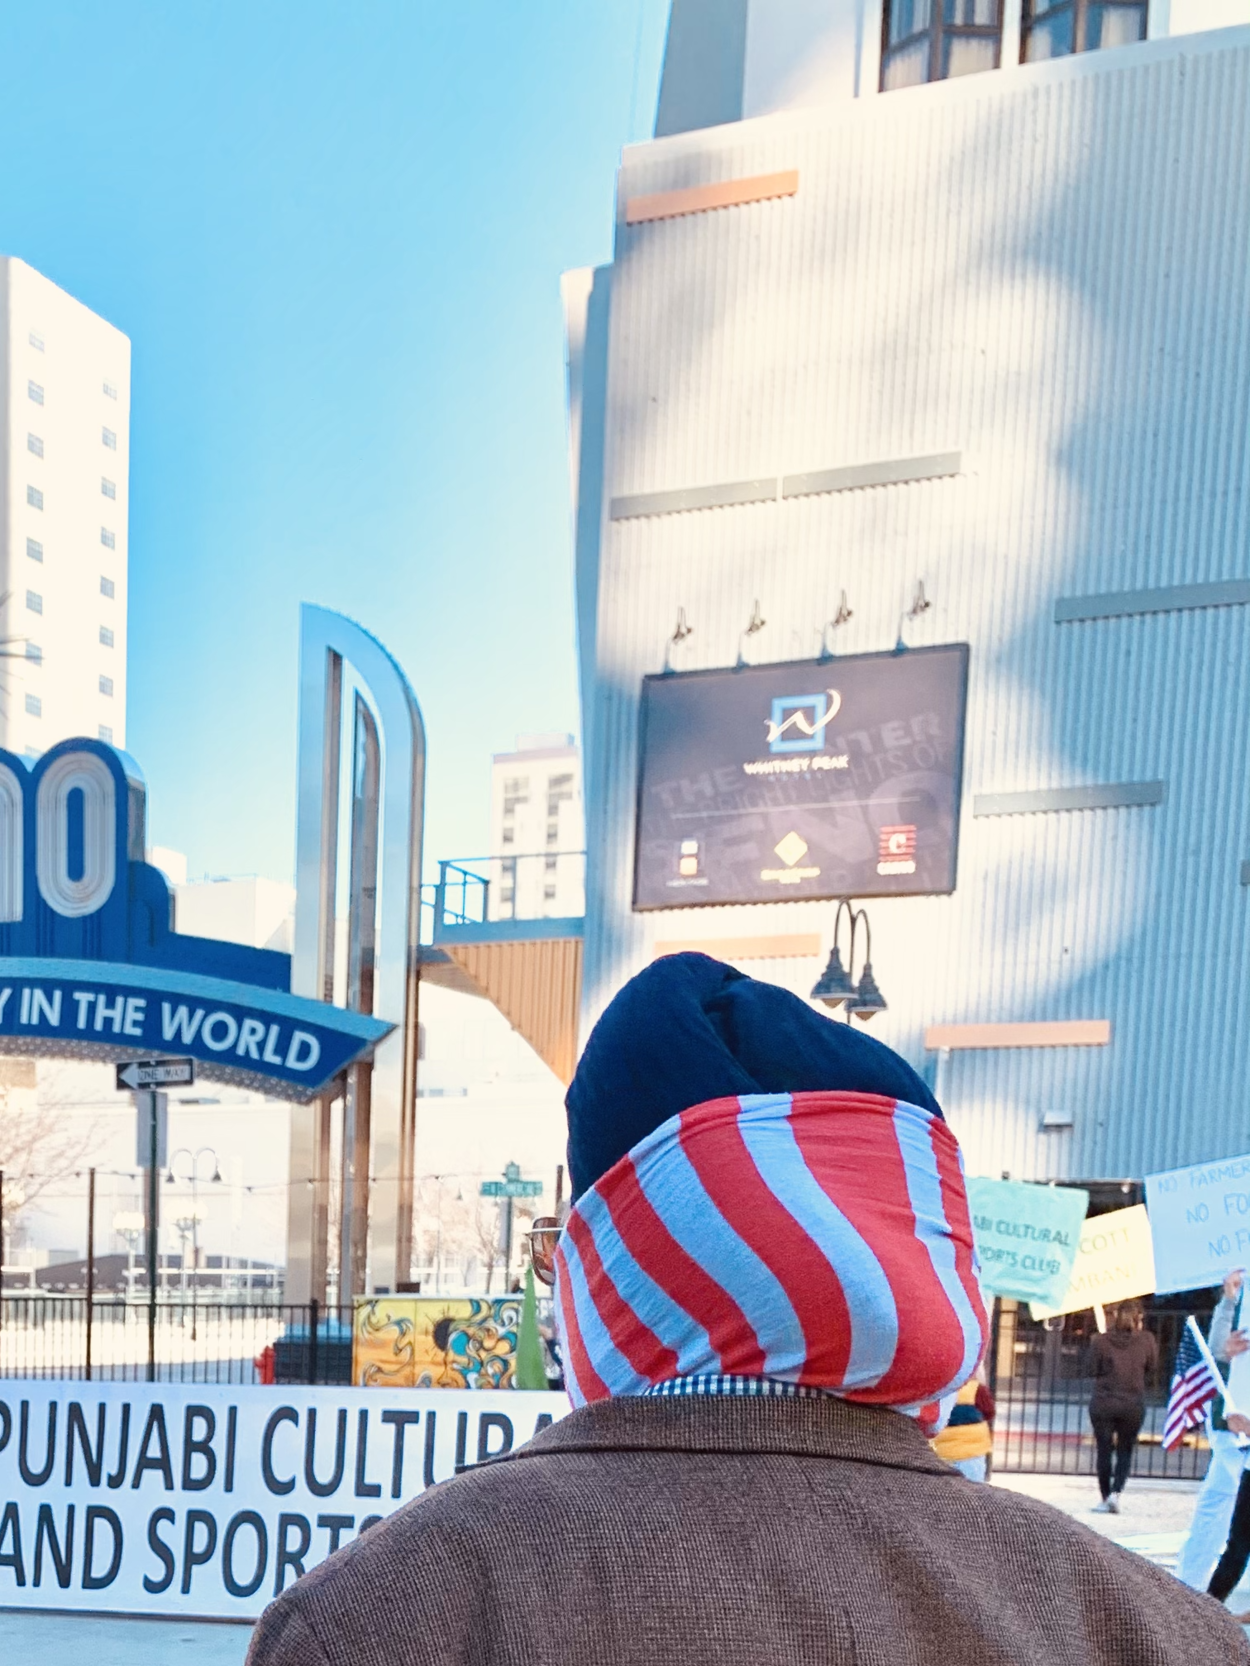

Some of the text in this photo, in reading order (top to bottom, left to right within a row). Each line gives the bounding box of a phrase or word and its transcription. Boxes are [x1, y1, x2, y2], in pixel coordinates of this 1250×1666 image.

[19, 988, 62, 1027] IN
[72, 991, 148, 1037] THE
[160, 1001, 322, 1072] WORLD
[1189, 1162, 1250, 1190] FARMER
[1186, 1192, 1250, 1224] NO FO
[995, 1219, 1071, 1247] CULTURAL
[1079, 1226, 1132, 1255] COTT
[1208, 1234, 1231, 1258] NO
[1020, 1254, 1062, 1276] CLUB
[260, 1405, 554, 1499] CULTUR
[141, 1506, 385, 1598] SPORT
